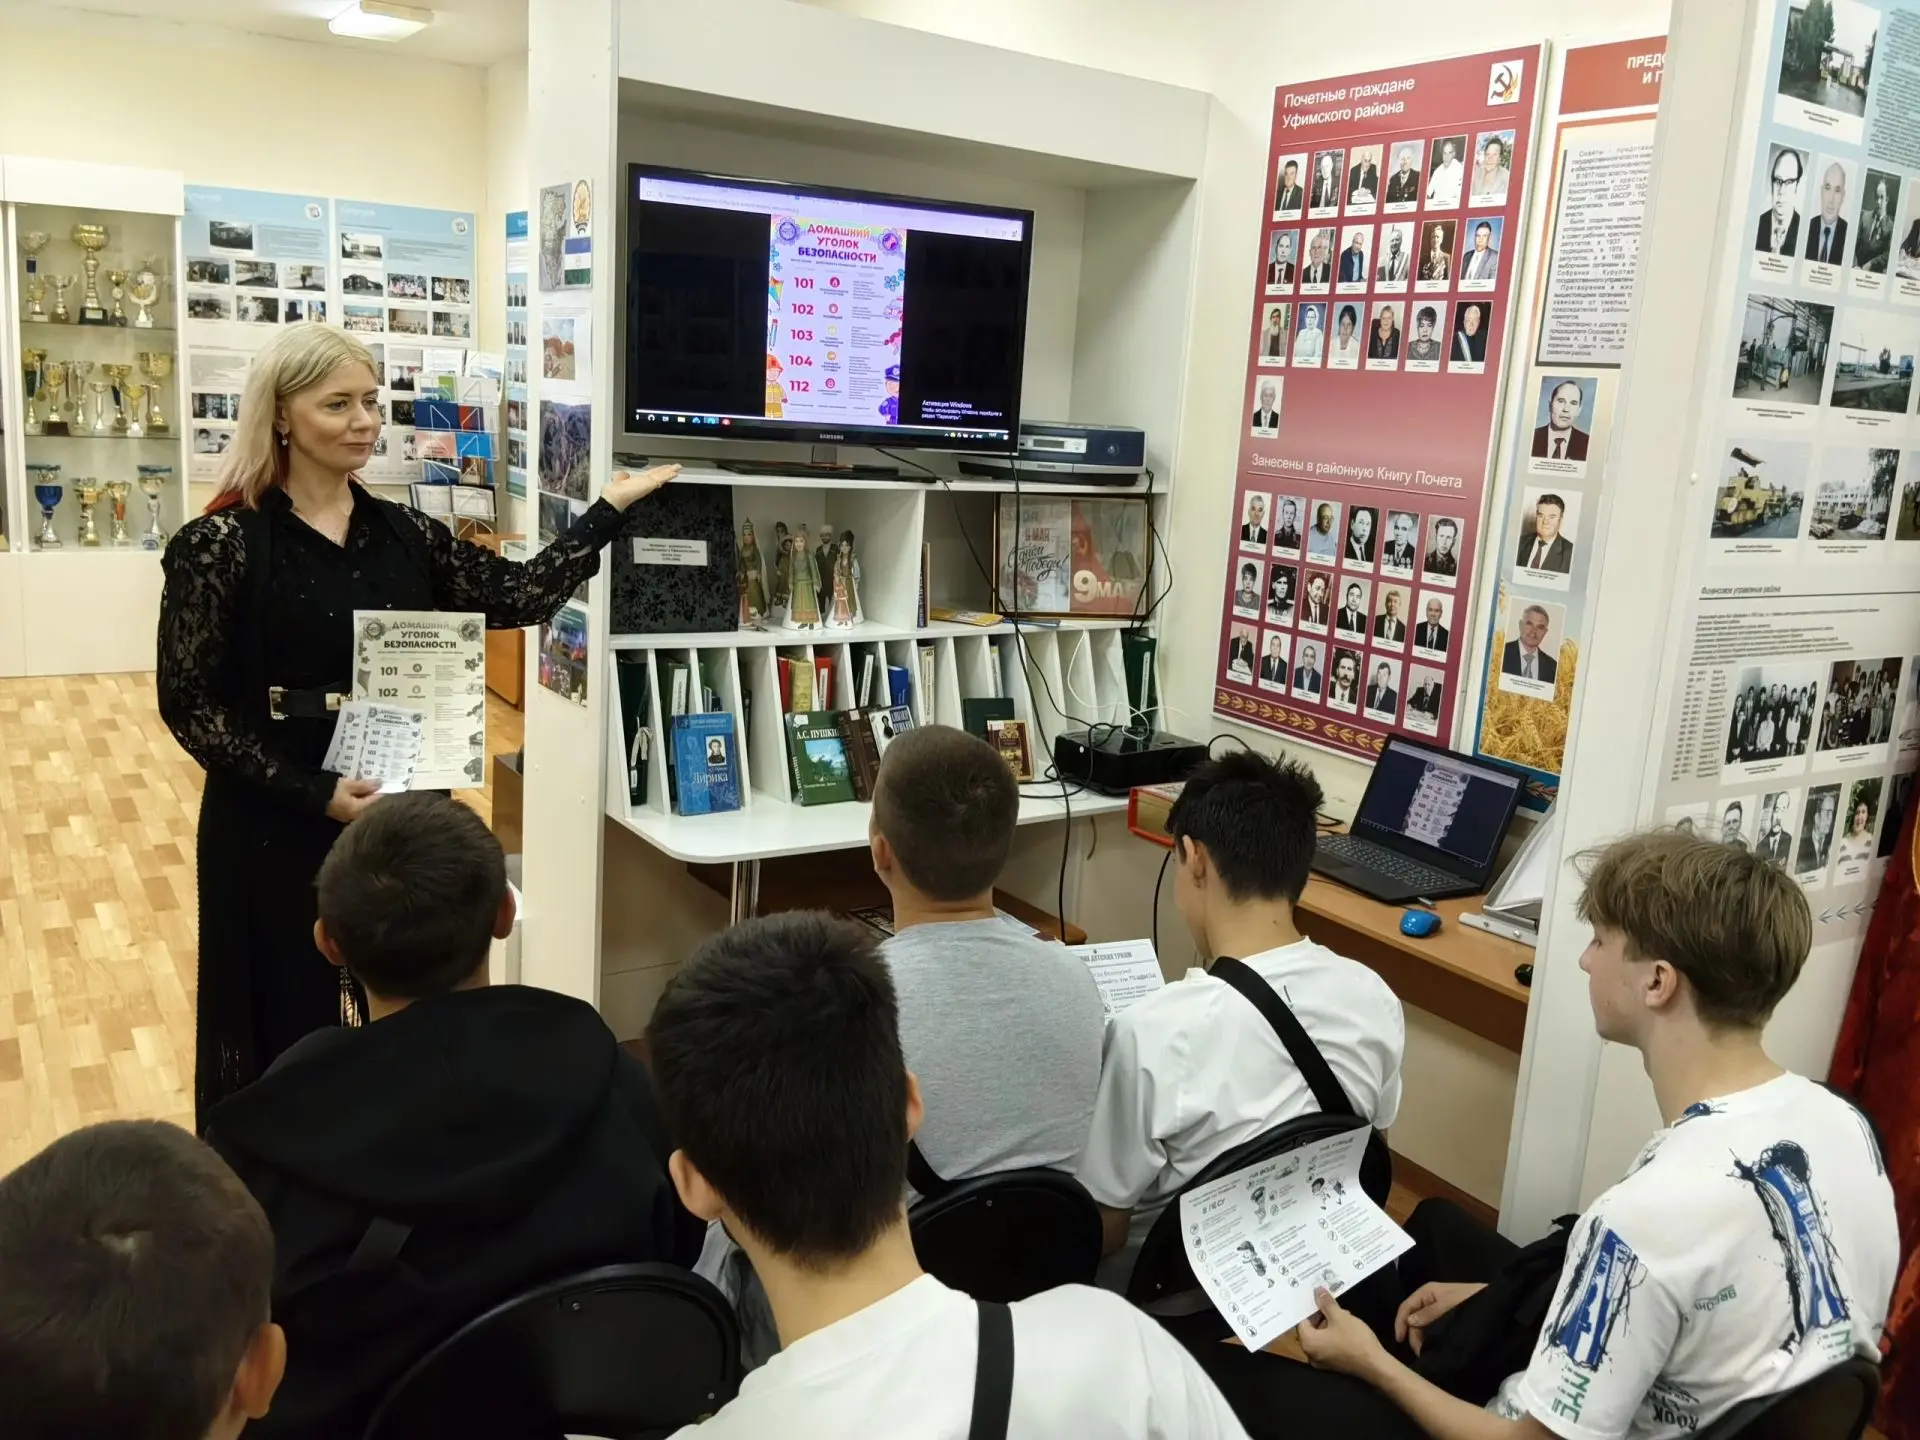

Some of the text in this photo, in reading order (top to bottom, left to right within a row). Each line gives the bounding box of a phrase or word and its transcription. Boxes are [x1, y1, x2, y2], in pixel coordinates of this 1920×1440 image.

[1642, 72, 1652, 84] И
[1284, 77, 1416, 108] Почетные граждане
[1282, 100, 1405, 129] Уфимского района
[807, 224, 872, 238] ДОМАШНИЙ
[817, 237, 859, 249] УГОЛОК
[798, 247, 877, 263] БЕЗОПАСНОСТИ
[794, 277, 814, 289] 101
[792, 303, 814, 315] 102
[790, 329, 813, 341] 103
[789, 355, 813, 366] 104
[789, 380, 809, 392] 112
[1251, 453, 1463, 488] Занесены в районную Книгу Почета
[1073, 570, 1098, 603] 9
[392, 621, 451, 630] ДОМАШНИЙ
[401, 631, 440, 639] УГОЛОК
[384, 641, 456, 649] БЕЗОПАСНОСТИ
[380, 666, 398, 676] 101
[378, 688, 399, 697] 102
[796, 728, 840, 739] А.С. ПУШКИ
[693, 773, 728, 785] Лирика
